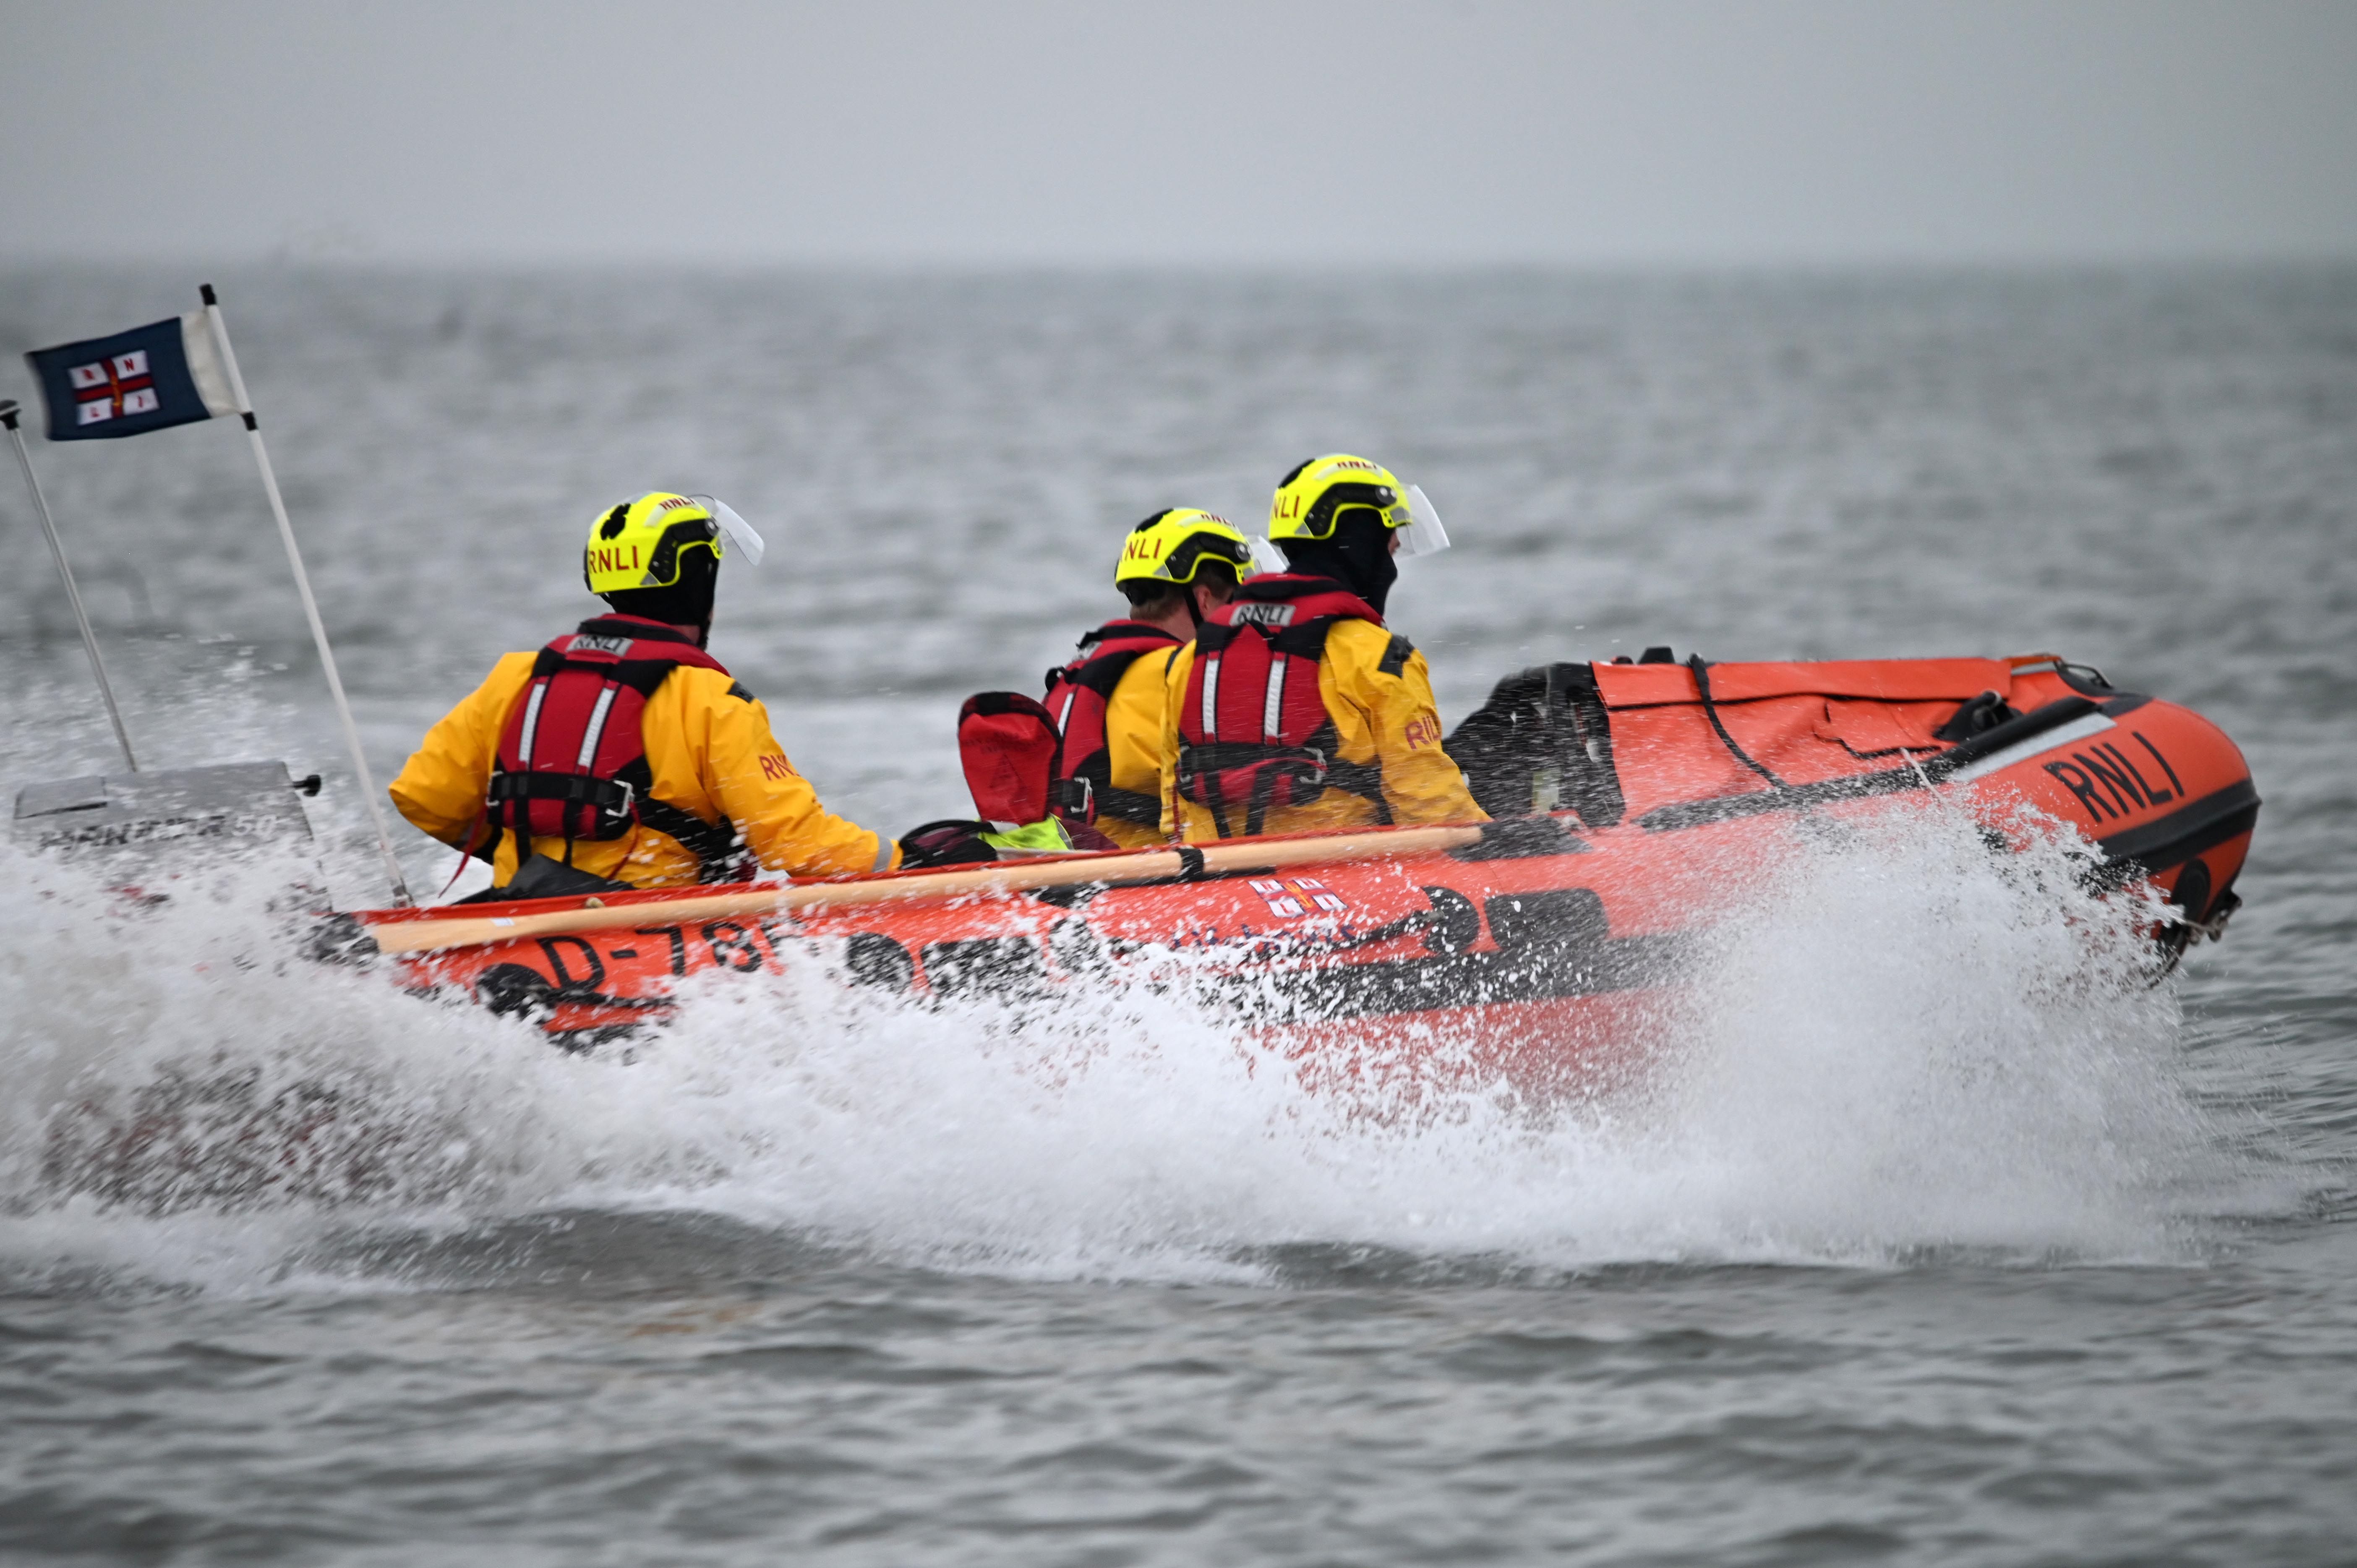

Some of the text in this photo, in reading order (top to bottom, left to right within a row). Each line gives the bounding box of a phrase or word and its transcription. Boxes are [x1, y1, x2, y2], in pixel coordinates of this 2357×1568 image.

[124, 358, 135, 371] N
[658, 496, 695, 511] RNLI
[1273, 495, 1300, 519] NLI
[589, 545, 639, 574] RNLI
[1120, 538, 1162, 563] NLI
[1237, 605, 1286, 624] RNLI
[2043, 731, 2184, 822] RNLI
